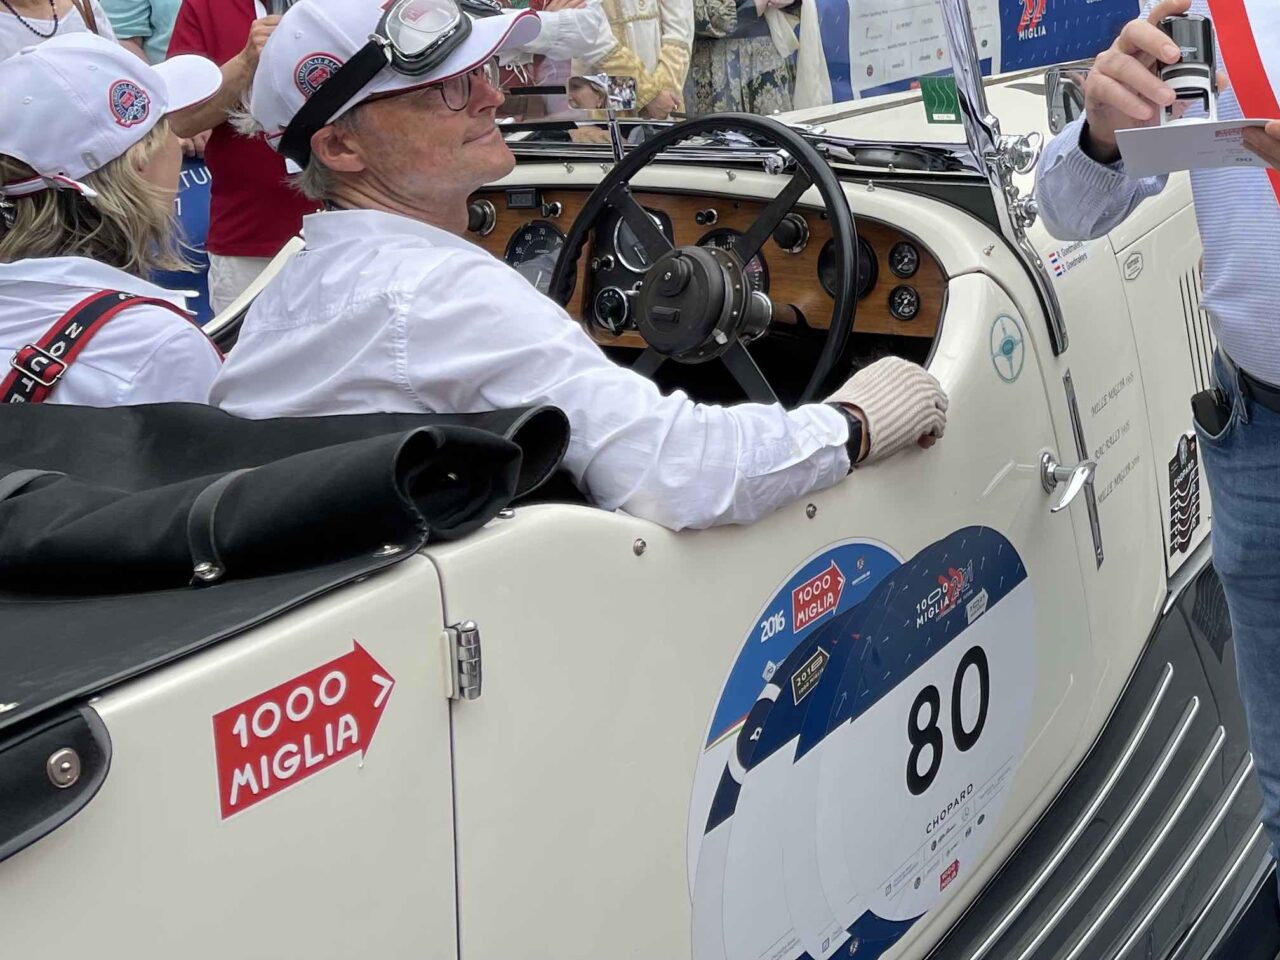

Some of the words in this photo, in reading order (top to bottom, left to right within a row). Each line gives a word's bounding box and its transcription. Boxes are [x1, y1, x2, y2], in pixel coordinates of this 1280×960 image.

[1018, 25, 1047, 41] MIGLIA
[1173, 459, 1195, 488] CHOPARD
[798, 575, 831, 605] 1000
[915, 582, 949, 614] 1000
[760, 609, 786, 644] 2016
[796, 592, 834, 627] MIGLIA
[916, 595, 950, 629] MIGLIA
[231, 670, 347, 748] 1000
[906, 645, 990, 796] 80
[229, 713, 359, 806] MIGLIA
[925, 783, 974, 835] CHOPARD
